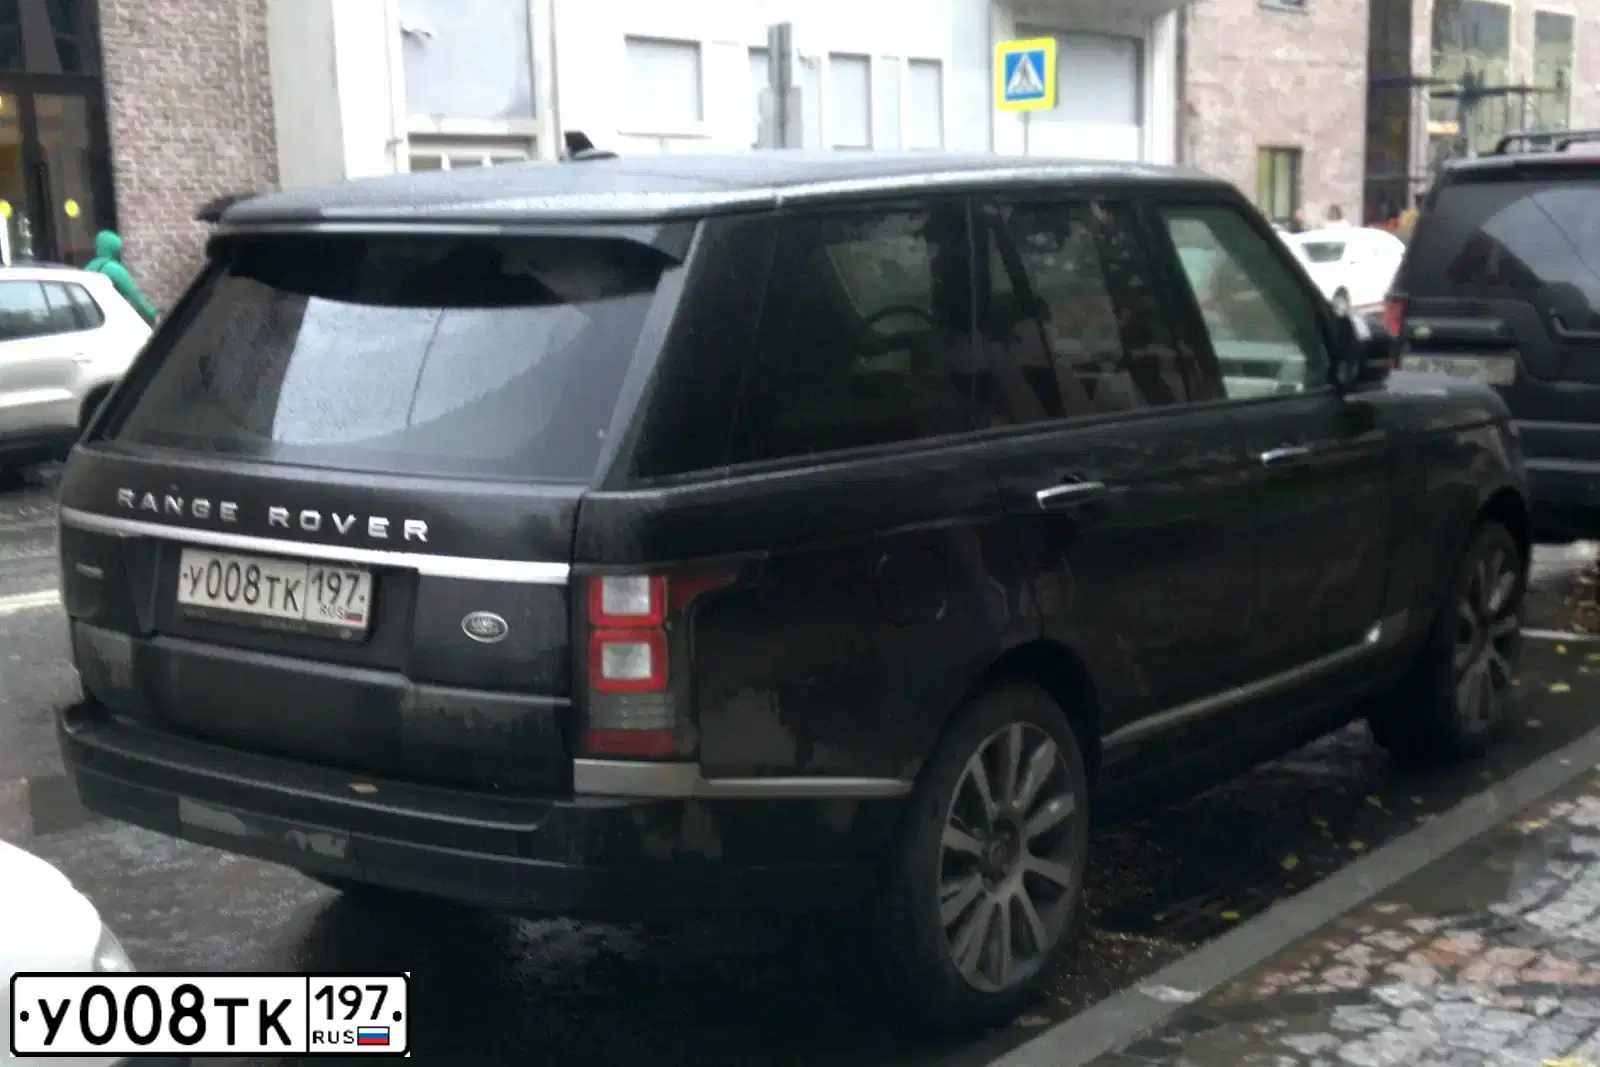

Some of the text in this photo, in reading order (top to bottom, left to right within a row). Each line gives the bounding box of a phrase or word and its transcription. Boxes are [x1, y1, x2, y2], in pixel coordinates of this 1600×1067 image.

[116, 487, 429, 542] RANGE ROVER
[311, 569, 360, 605] 197
[319, 603, 346, 620] RUS
